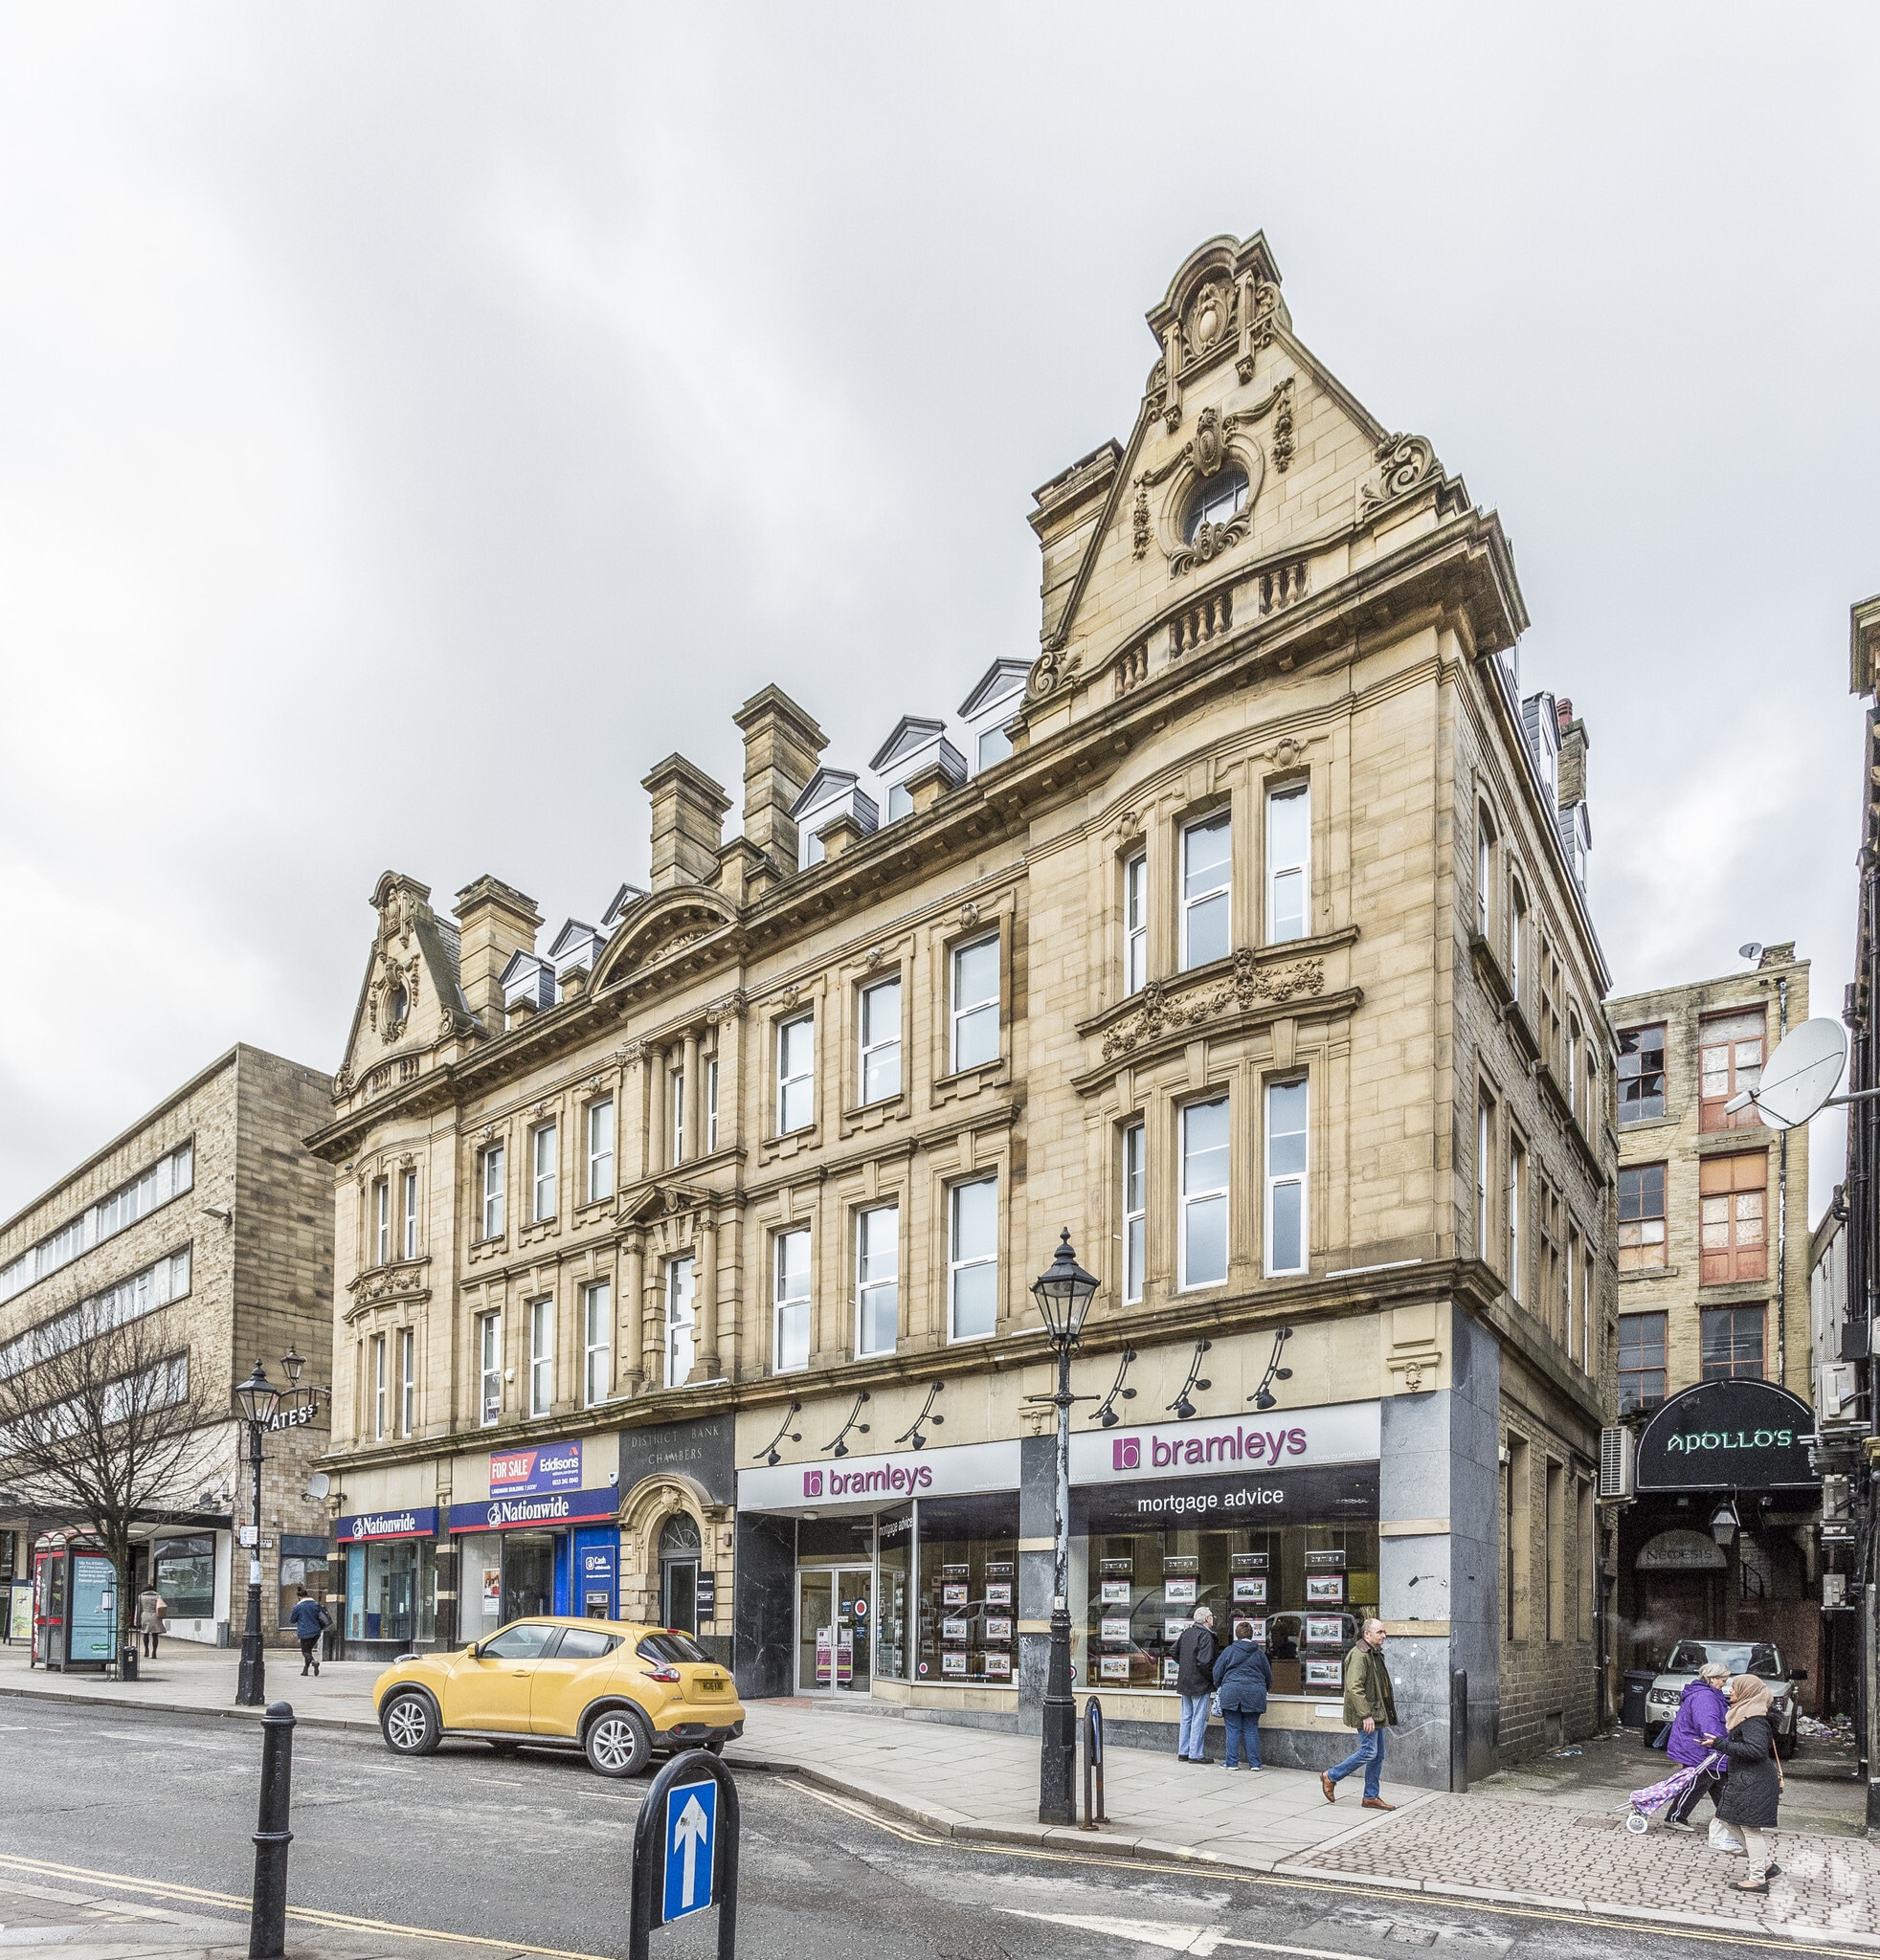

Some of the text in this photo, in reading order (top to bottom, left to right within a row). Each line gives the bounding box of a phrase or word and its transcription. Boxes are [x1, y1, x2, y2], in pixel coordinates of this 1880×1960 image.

[632, 1425, 719, 1448] DISTRICT BANK
[1152, 1426, 1307, 1466] bramleys
[1667, 1429, 1793, 1455] APOLLO'S
[540, 1457, 579, 1473] Eddisons
[648, 1447, 703, 1464] CHAMBERS
[491, 1459, 528, 1480] FOR SALE
[829, 1463, 932, 1495] bramleys
[502, 1496, 570, 1522] Nationwide
[1137, 1487, 1285, 1514] mortgage advice
[364, 1513, 415, 1535] Nationwide
